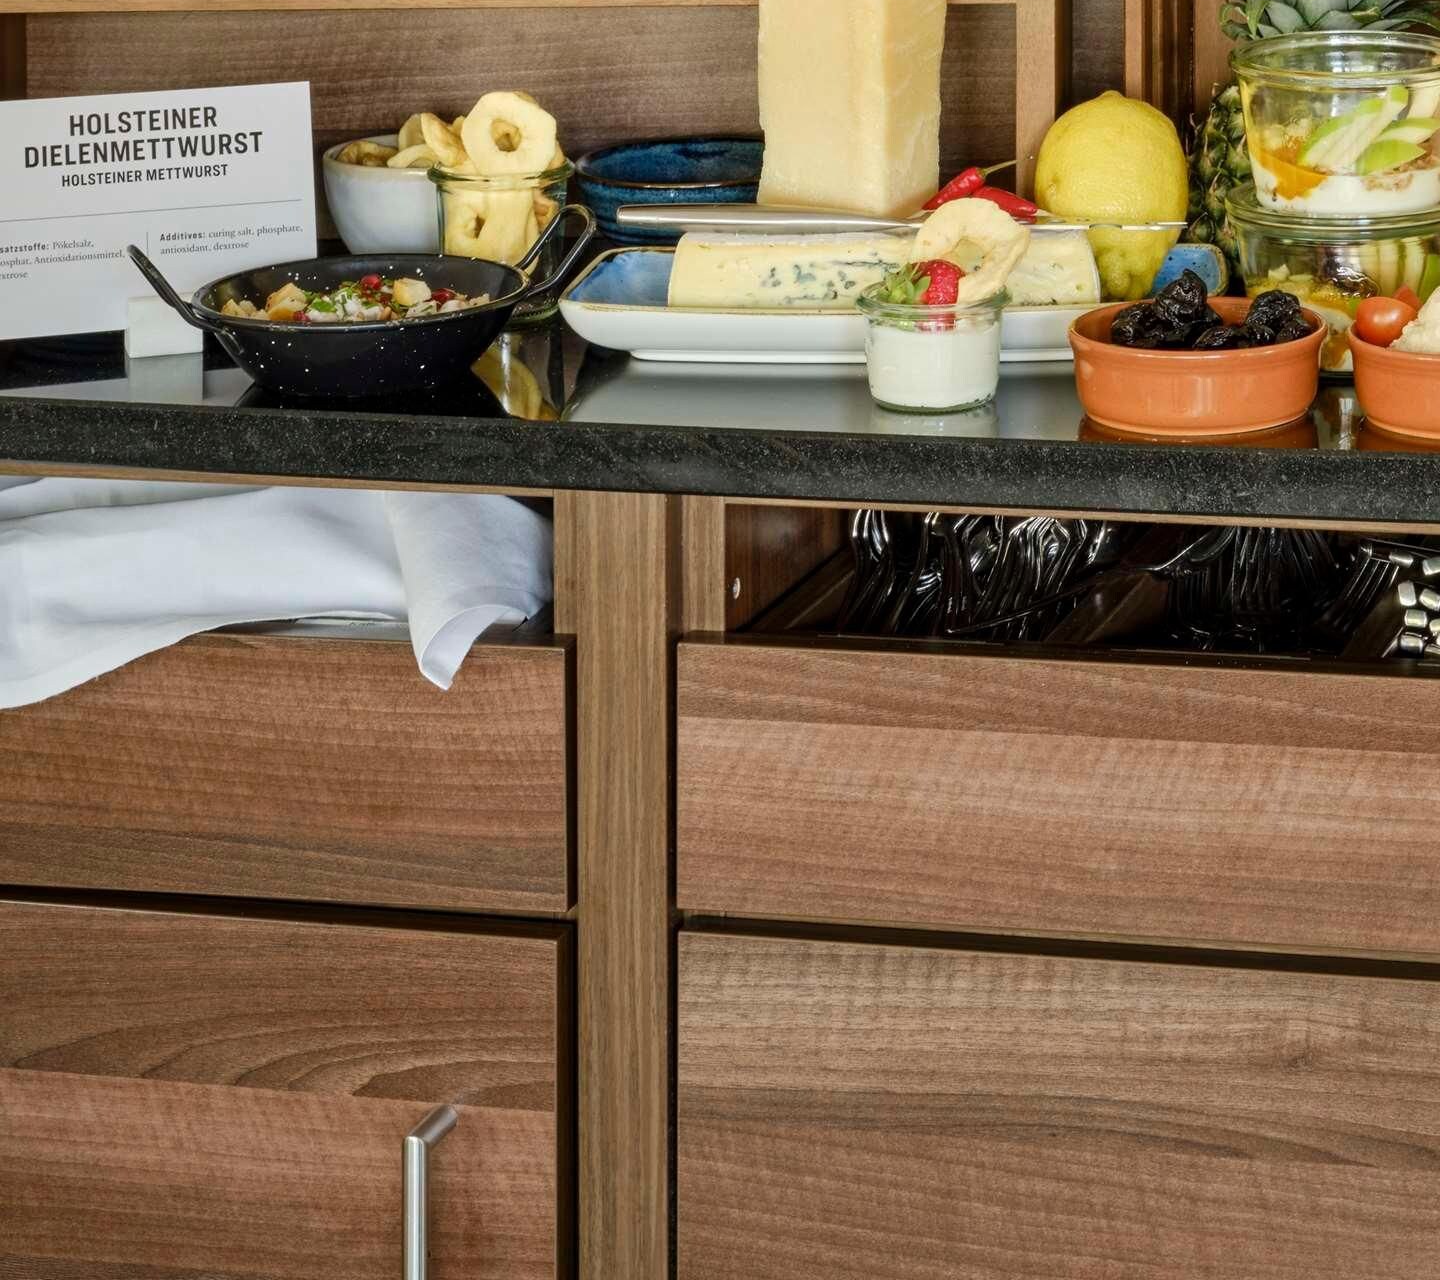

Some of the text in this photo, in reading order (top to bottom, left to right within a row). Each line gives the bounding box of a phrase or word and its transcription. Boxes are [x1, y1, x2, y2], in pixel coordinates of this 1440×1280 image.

[69, 106, 217, 136] HOLSTEINER
[24, 131, 263, 168] DIELENMETTWURST
[61, 163, 228, 187] HOLSTEINER METTWURST
[159, 231, 205, 241] Additives:
[208, 228, 236, 243] curing
[256, 224, 303, 237] phosphate,
[0, 242, 49, 254] satzstoffe:
[0, 256, 32, 269] osphat,
